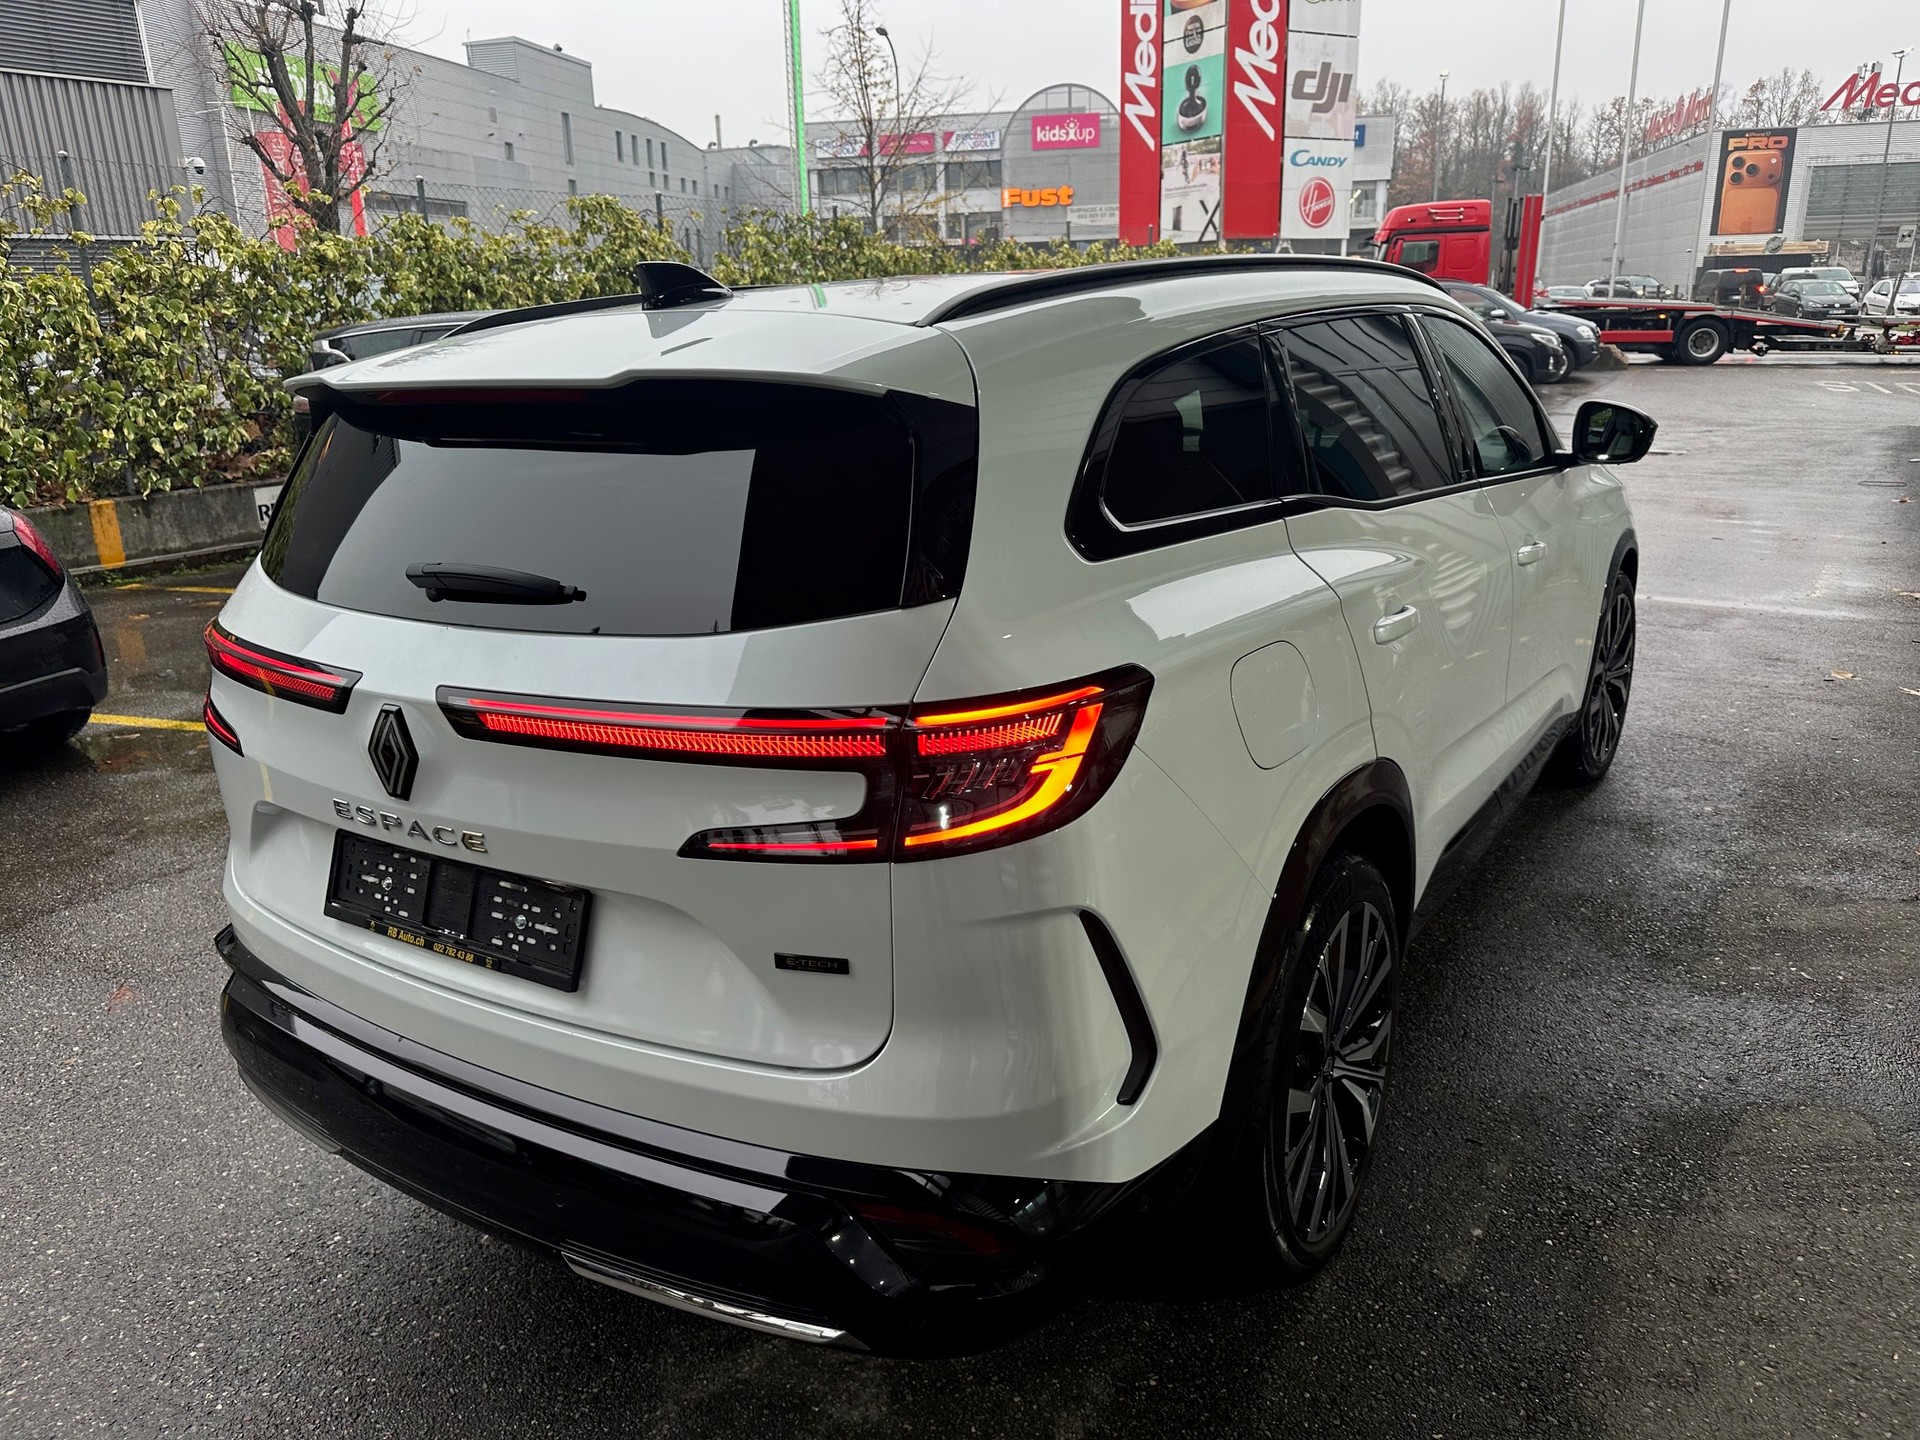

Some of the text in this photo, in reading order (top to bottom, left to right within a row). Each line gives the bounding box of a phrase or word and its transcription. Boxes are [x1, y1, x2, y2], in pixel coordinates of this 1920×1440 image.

[1727, 135, 1789, 151] PRO
[1289, 149, 1348, 168] CANDY
[1002, 184, 1075, 208] Fust
[332, 797, 488, 854] ESPACE
[387, 926, 398, 938] RB
[398, 930, 425, 947] Auto.ch
[433, 943, 444, 954] 022
[456, 950, 465, 960] 43
